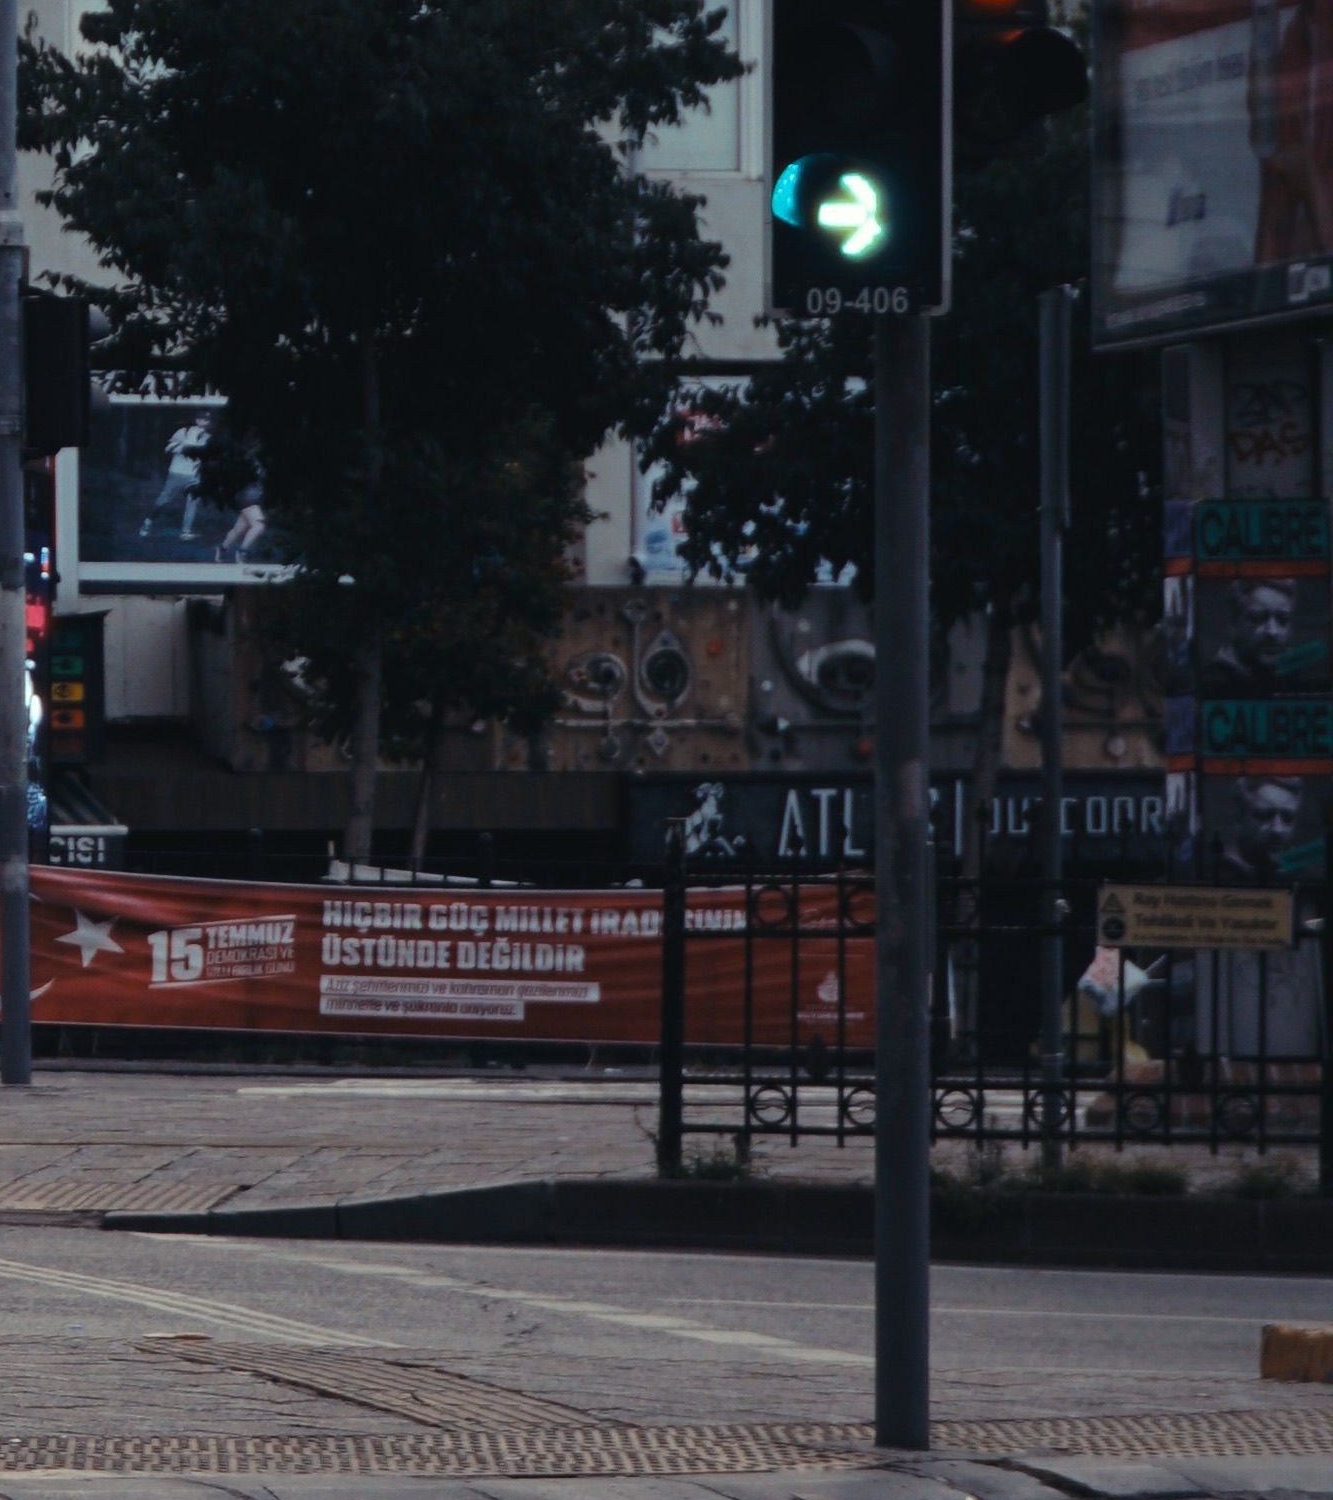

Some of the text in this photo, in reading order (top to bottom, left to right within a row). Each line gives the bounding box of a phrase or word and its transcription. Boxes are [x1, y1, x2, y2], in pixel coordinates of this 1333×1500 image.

[806, 286, 909, 314] 09-406
[1201, 506, 1326, 556] CALIBRE
[1207, 705, 1333, 754] CALIBRE
[428, 902, 489, 937] GÜÇ
[148, 919, 295, 983] 15 TEMMUZ
[321, 933, 584, 972] ÜSTÜNDE DEĞİLDİR
